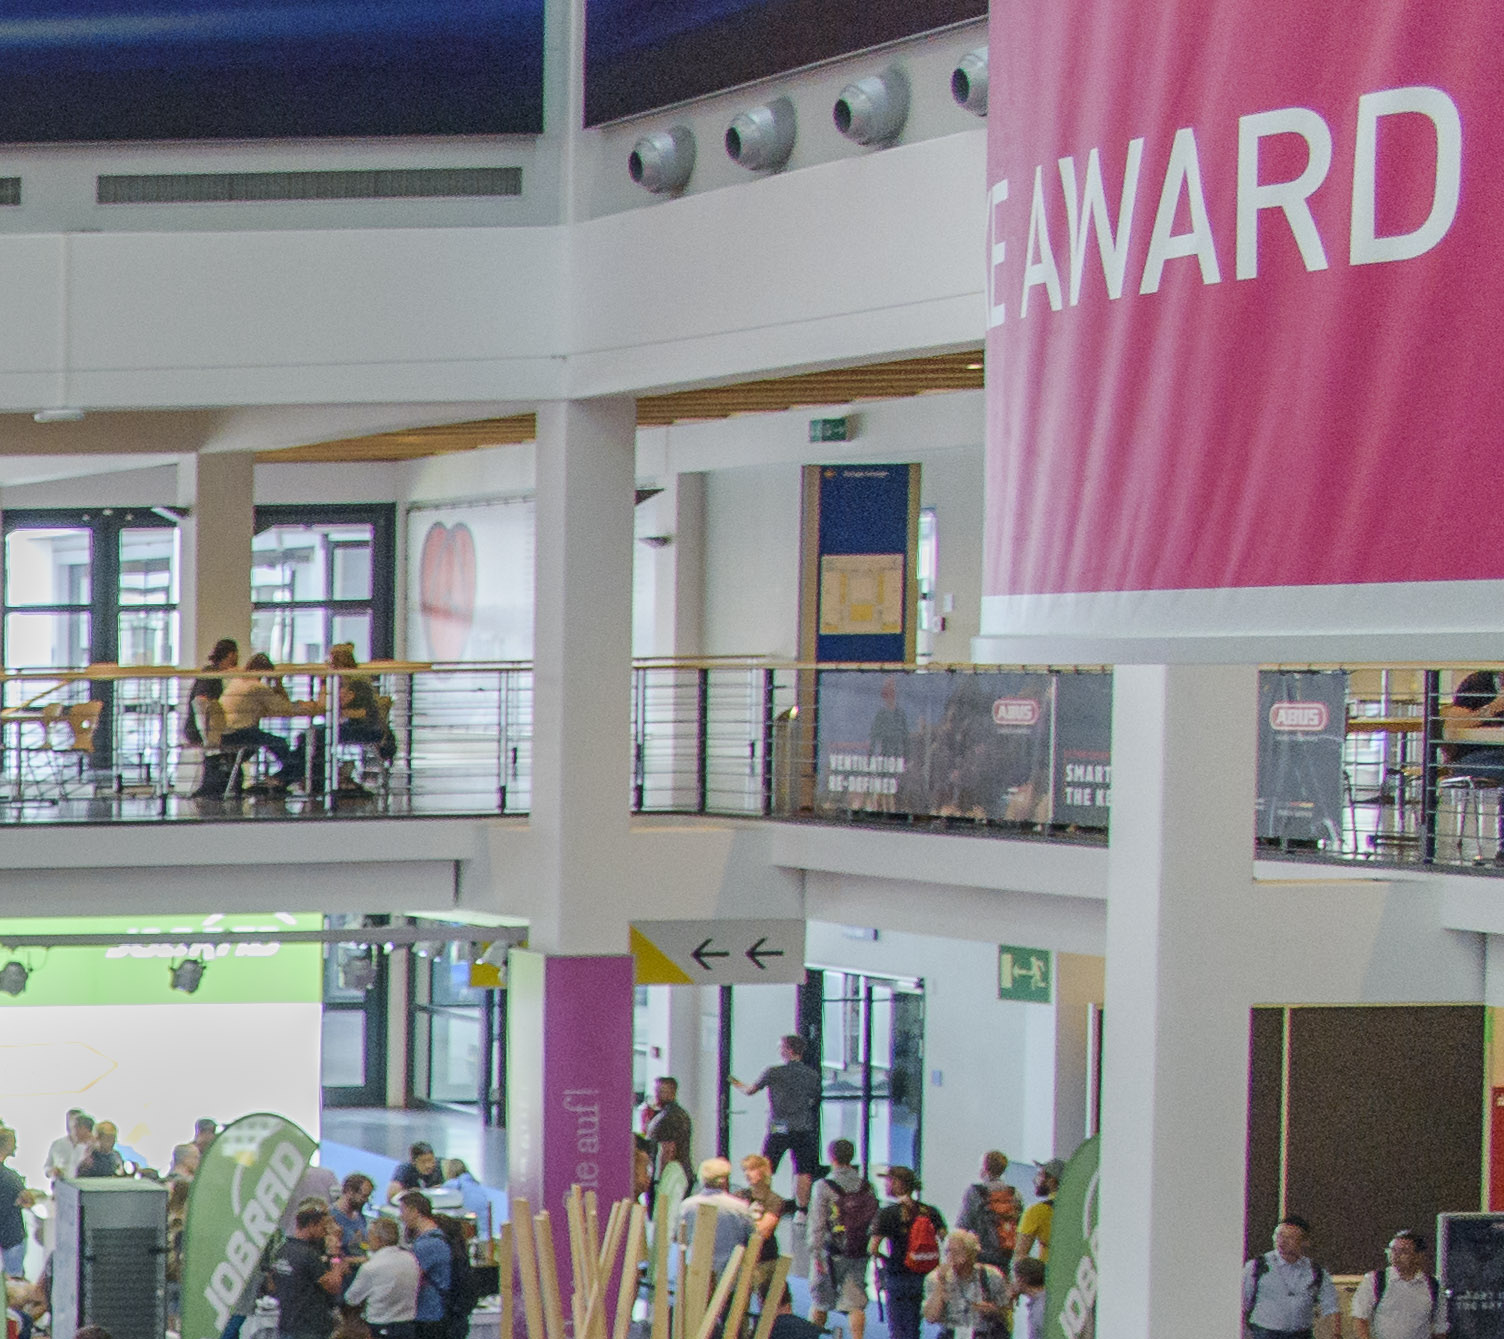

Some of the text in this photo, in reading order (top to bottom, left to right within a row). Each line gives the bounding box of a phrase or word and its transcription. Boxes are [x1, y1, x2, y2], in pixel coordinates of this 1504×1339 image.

[1020, 85, 1462, 318] AWARD
[997, 705, 1034, 722] ABUS
[1276, 708, 1320, 726] ABUS
[829, 754, 906, 774] VENTILATION
[1065, 763, 1111, 783] SMART
[827, 775, 899, 794] RE-DEFINED
[1065, 787, 1092, 806] THE
[204, 1141, 305, 1331] JOBRAD
